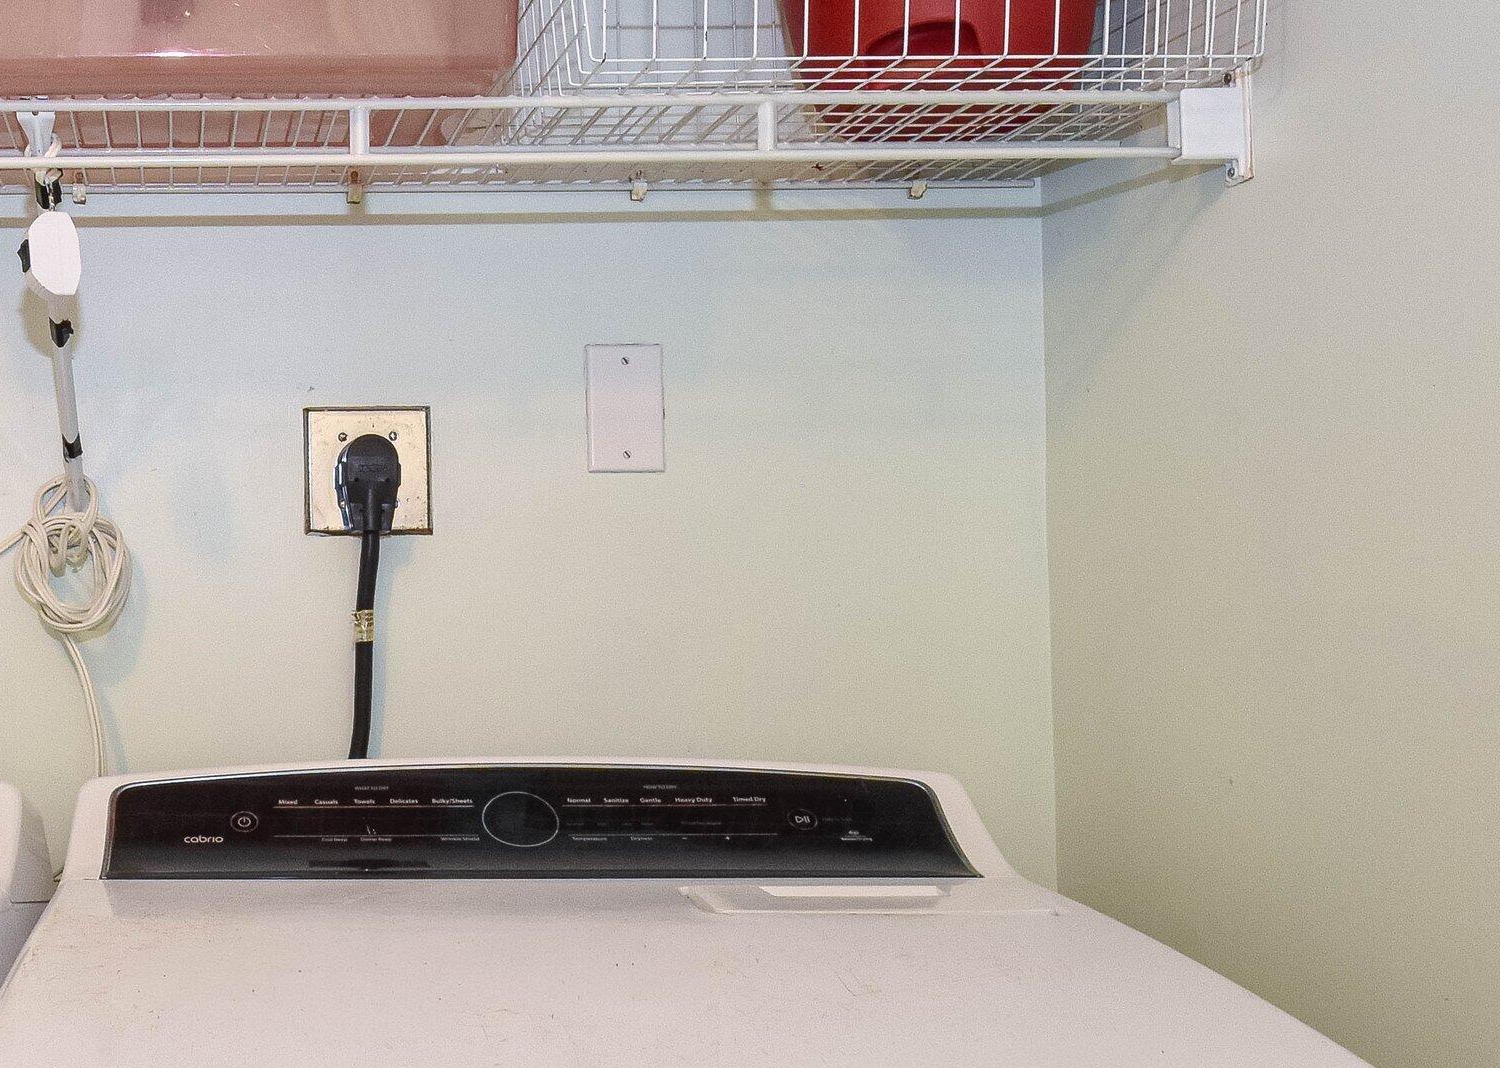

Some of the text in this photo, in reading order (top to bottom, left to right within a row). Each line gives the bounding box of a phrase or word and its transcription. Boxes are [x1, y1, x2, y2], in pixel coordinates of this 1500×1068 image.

[603, 796, 629, 804] Sanitize
[639, 796, 661, 804] Gentle
[675, 796, 713, 804] Heavy Duty
[184, 834, 224, 844] cabrio
